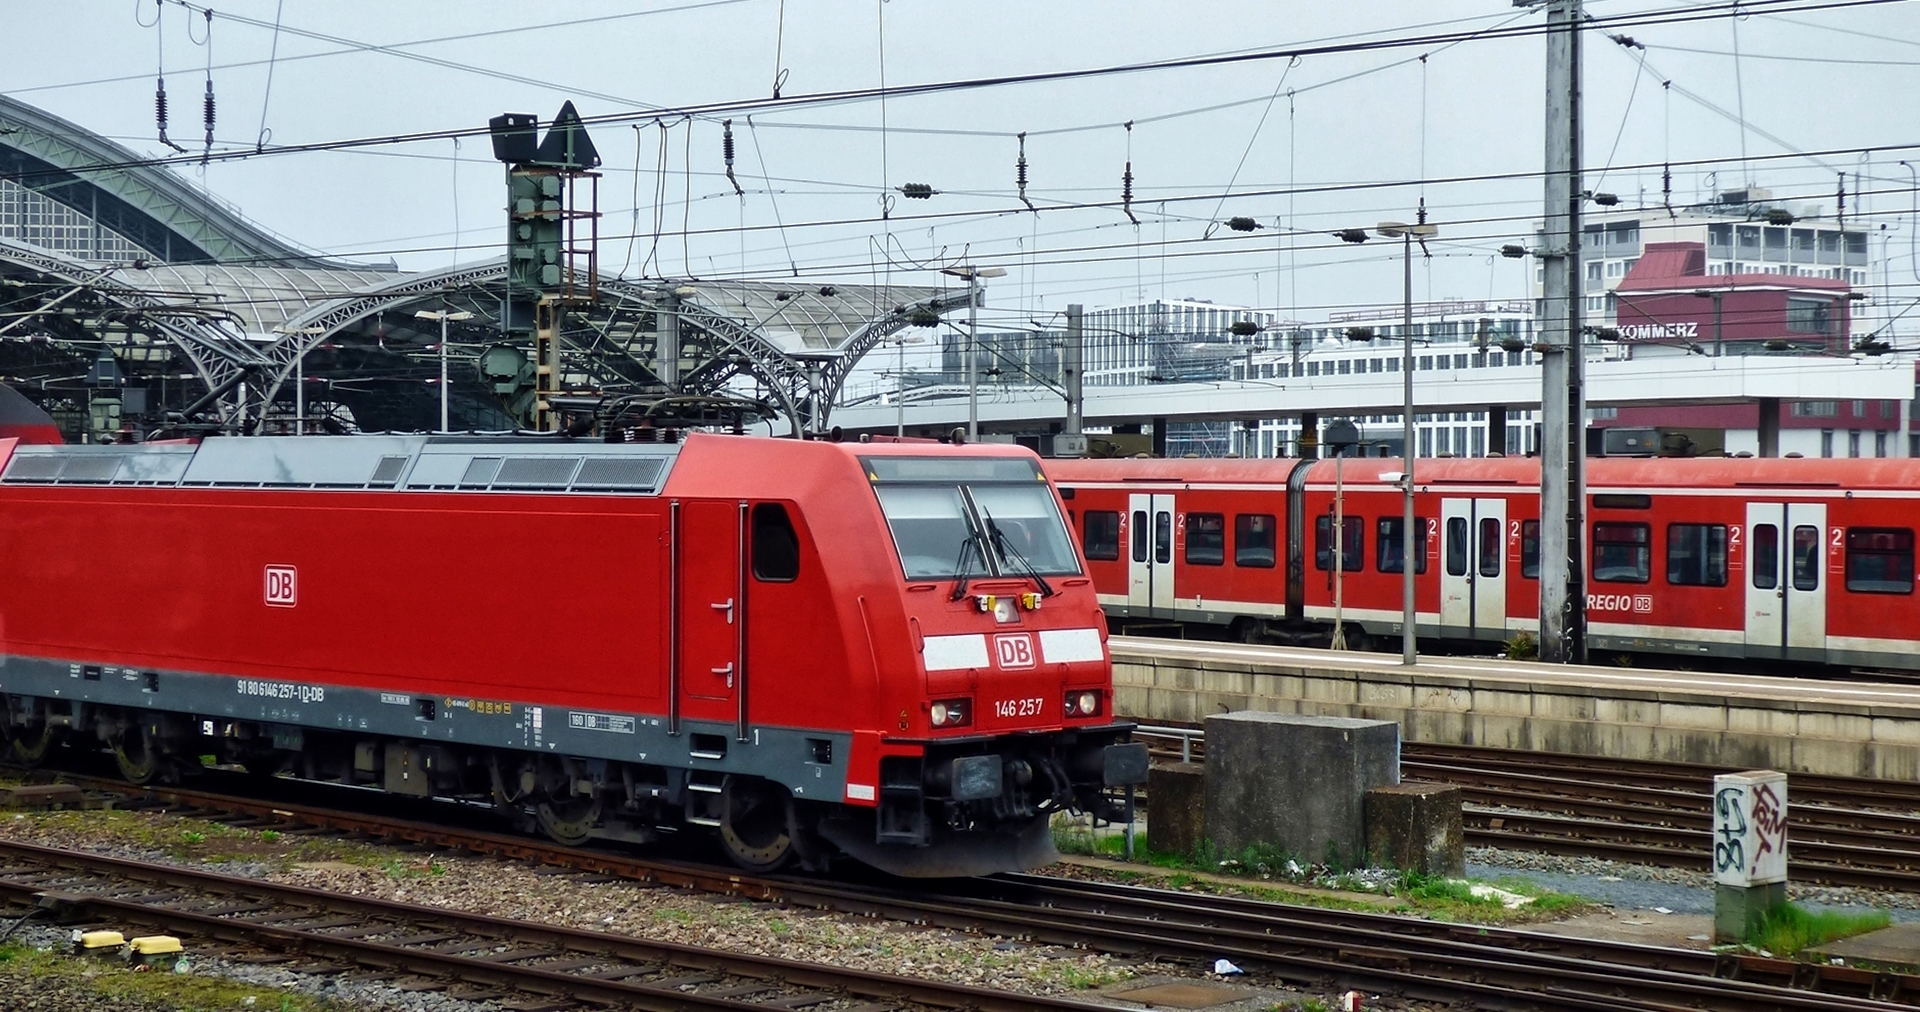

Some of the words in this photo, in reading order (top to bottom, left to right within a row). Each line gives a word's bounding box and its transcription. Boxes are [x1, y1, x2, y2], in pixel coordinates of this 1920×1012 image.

[1617, 322, 1698, 339] KOMMERZ
[1120, 512, 1127, 526] 2
[1177, 514, 1185, 528] 2
[1428, 519, 1437, 535] 2
[1510, 521, 1520, 537] 2
[1730, 526, 1741, 543] 2
[1831, 528, 1842, 546] 2
[269, 572, 293, 599] DB
[1586, 594, 1632, 611] REGIO
[1636, 597, 1650, 610] DB
[999, 639, 1031, 664] DB
[237, 680, 247, 695] 91
[247, 681, 258, 696] 80
[259, 682, 278, 698] 6146
[278, 684, 302, 699] 257-1
[994, 699, 1016, 718] 146
[1019, 698, 1043, 717] 257
[571, 714, 583, 726] 160
[587, 716, 597, 728] DB
[753, 728, 760, 746] 1
